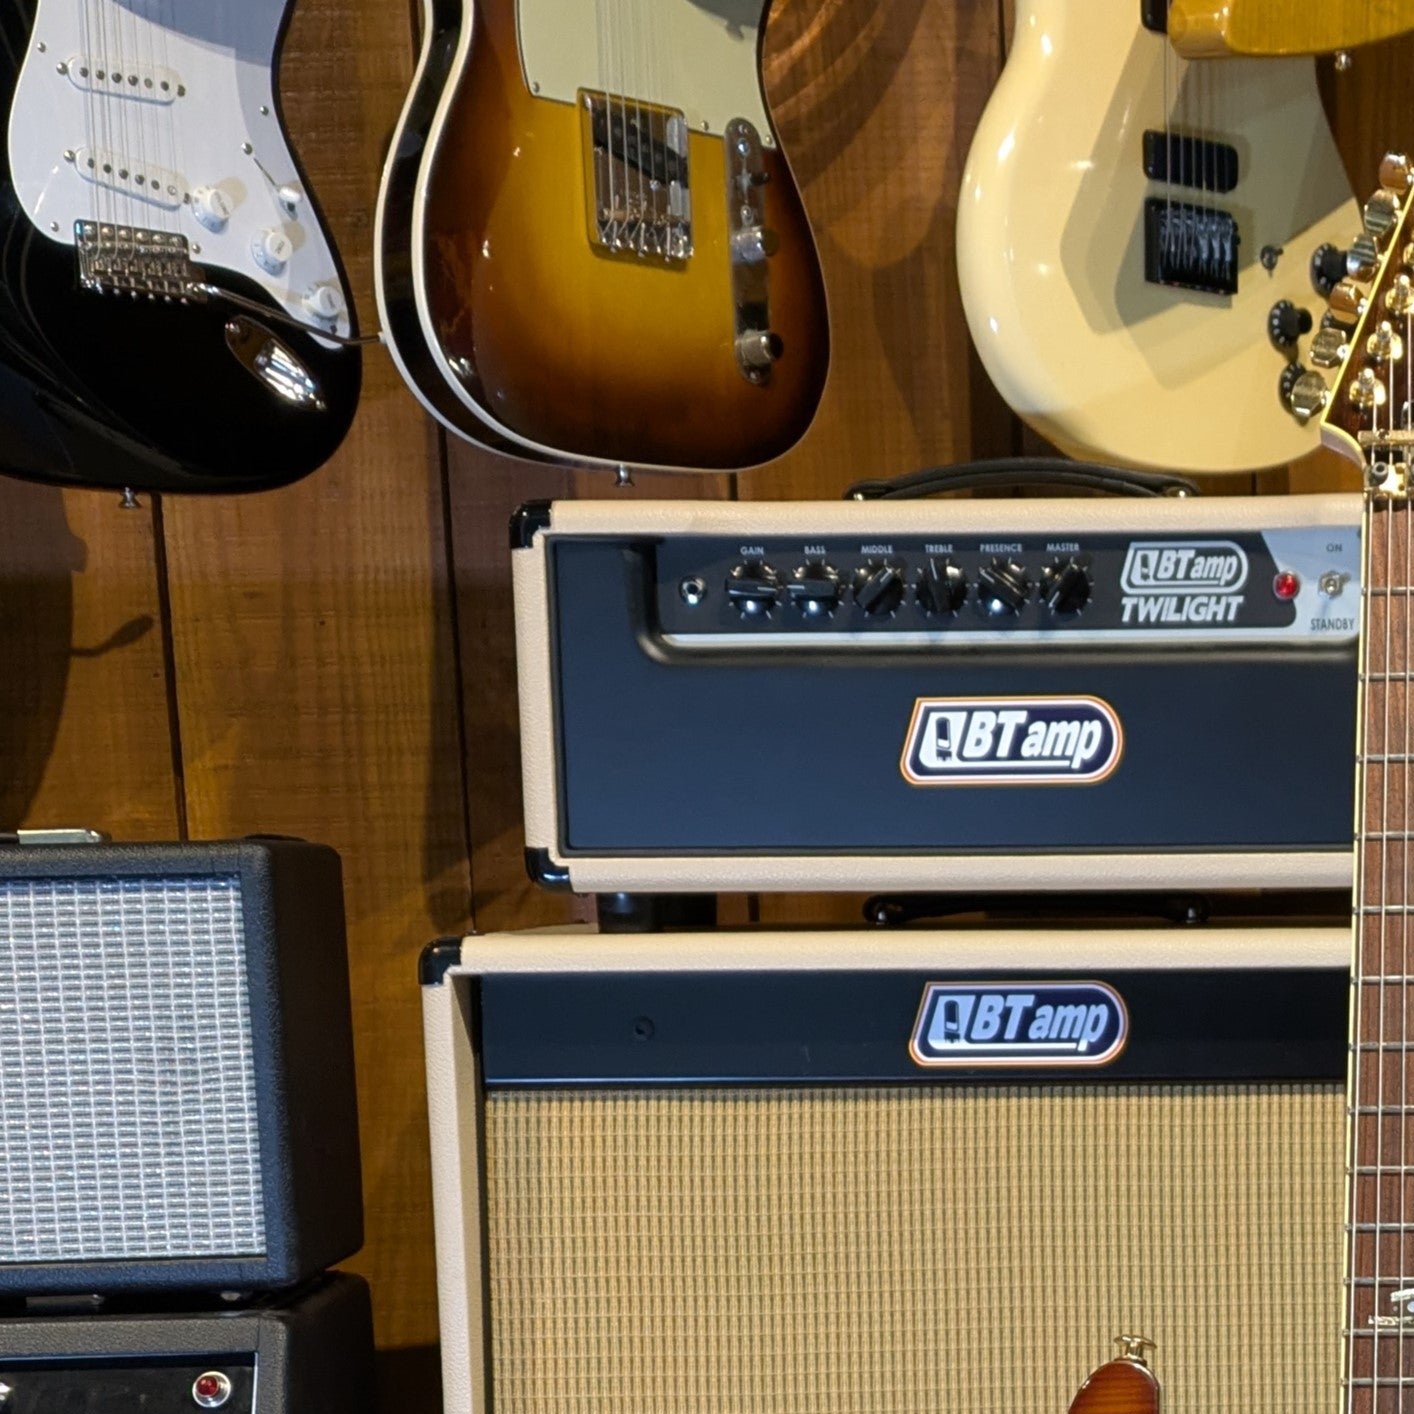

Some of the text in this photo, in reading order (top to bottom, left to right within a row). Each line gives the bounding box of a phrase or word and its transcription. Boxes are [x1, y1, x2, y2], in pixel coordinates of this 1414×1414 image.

[740, 546, 764, 555] GAIN
[804, 546, 826, 555] BASS
[861, 545, 893, 554] MIDDLE
[925, 544, 953, 553] TREBLE
[979, 543, 1022, 553] PRESENCE
[1046, 543, 1079, 552] MASTER
[1326, 543, 1343, 553] ON
[1121, 595, 1245, 622] TWILIGHT
[1310, 618, 1355, 631] STANDBY
